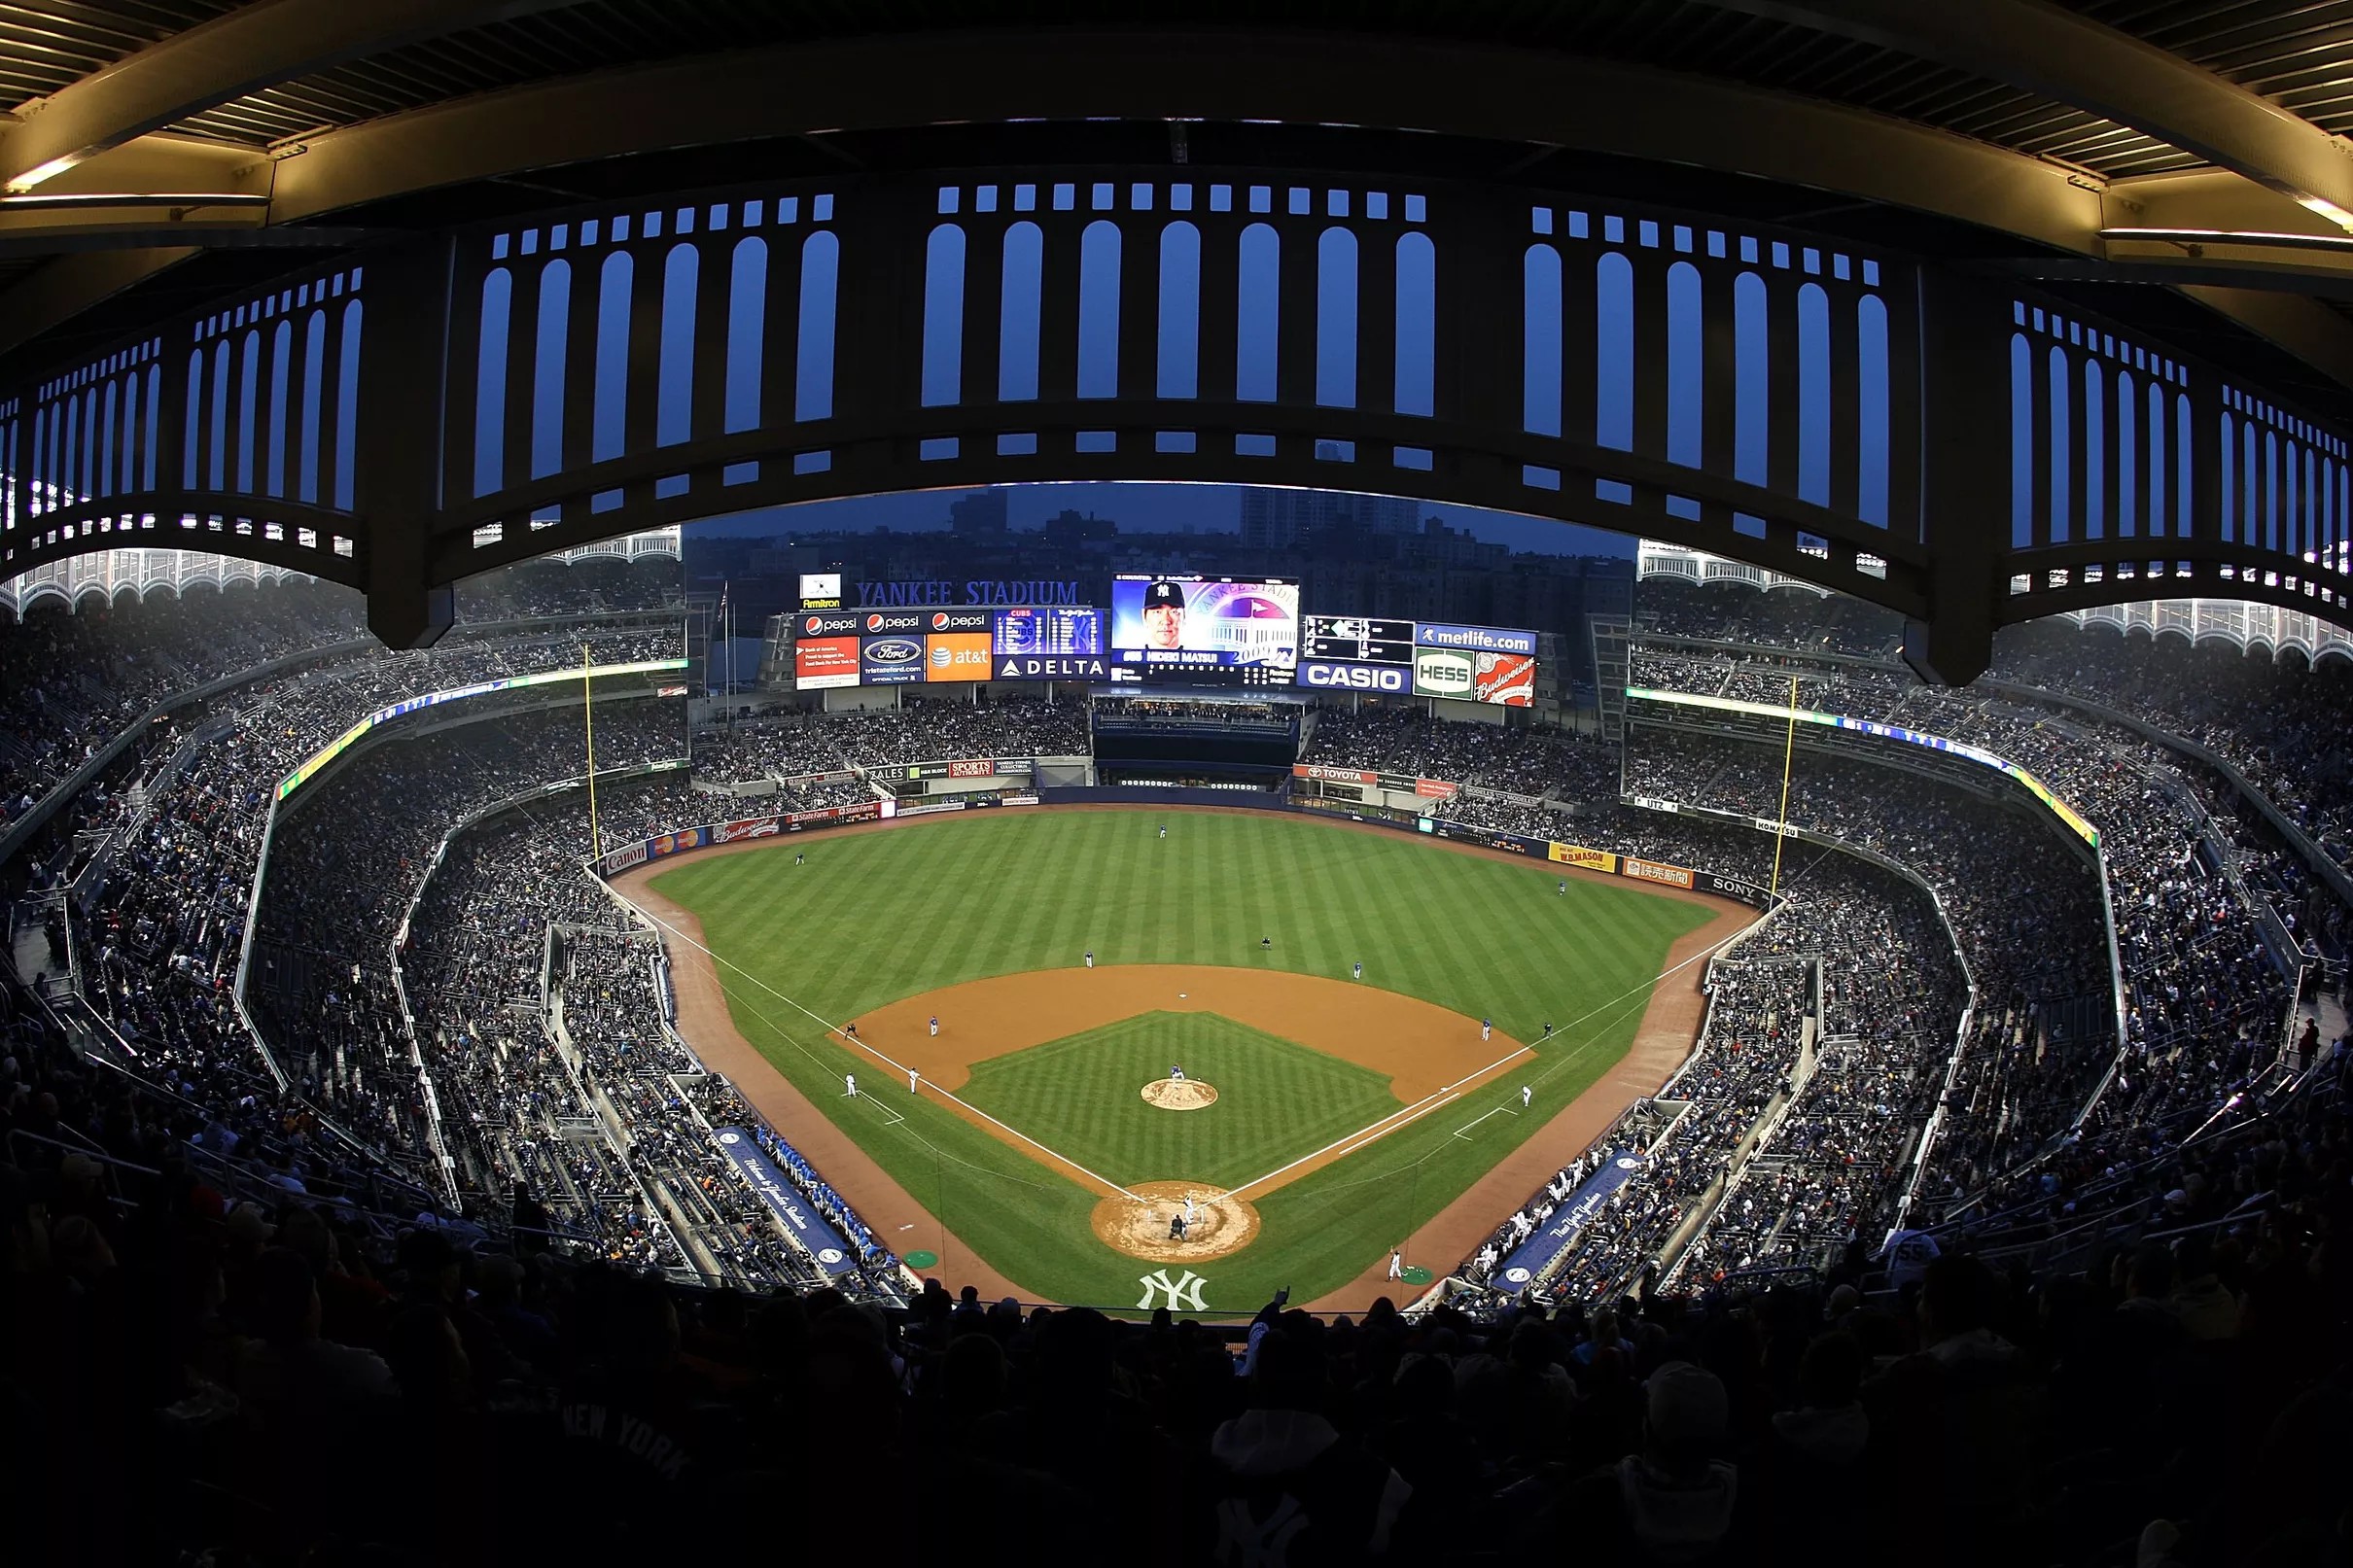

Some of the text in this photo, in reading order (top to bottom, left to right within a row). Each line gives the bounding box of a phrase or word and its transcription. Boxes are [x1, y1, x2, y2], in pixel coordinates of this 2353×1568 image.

[857, 579, 1079, 607] YANKEE STADIUM
[802, 599, 840, 609] Armitron
[824, 617, 857, 633] pepsi
[885, 615, 919, 630] pepsi
[950, 614, 985, 629] pepsi
[1437, 630, 1529, 651] metlife.com
[877, 645, 908, 659] Ford
[955, 647, 989, 665] at&t
[1181, 652, 1218, 665] MATSUI
[1232, 645, 1271, 663] 2009
[864, 666, 922, 675] tristateford.com
[1027, 660, 1104, 675] DELTA
[1420, 665, 1468, 682] HESS
[1307, 665, 1402, 690] CASIO
[1474, 657, 1535, 701] Budweiser
[870, 767, 903, 780] ZALES
[952, 761, 991, 772] SPORTS
[1323, 768, 1362, 783] TOYOTA
[1646, 799, 1664, 810] UTZ
[716, 817, 770, 843] Budweiser
[608, 846, 646, 870] Canon
[1640, 863, 1689, 885] 読売新聞
[1713, 877, 1756, 898] SONY
[1549, 1192, 1602, 1238] New York Yankees
[1136, 1269, 1210, 1311] NY
[561, 1402, 691, 1481] NEW YORK
